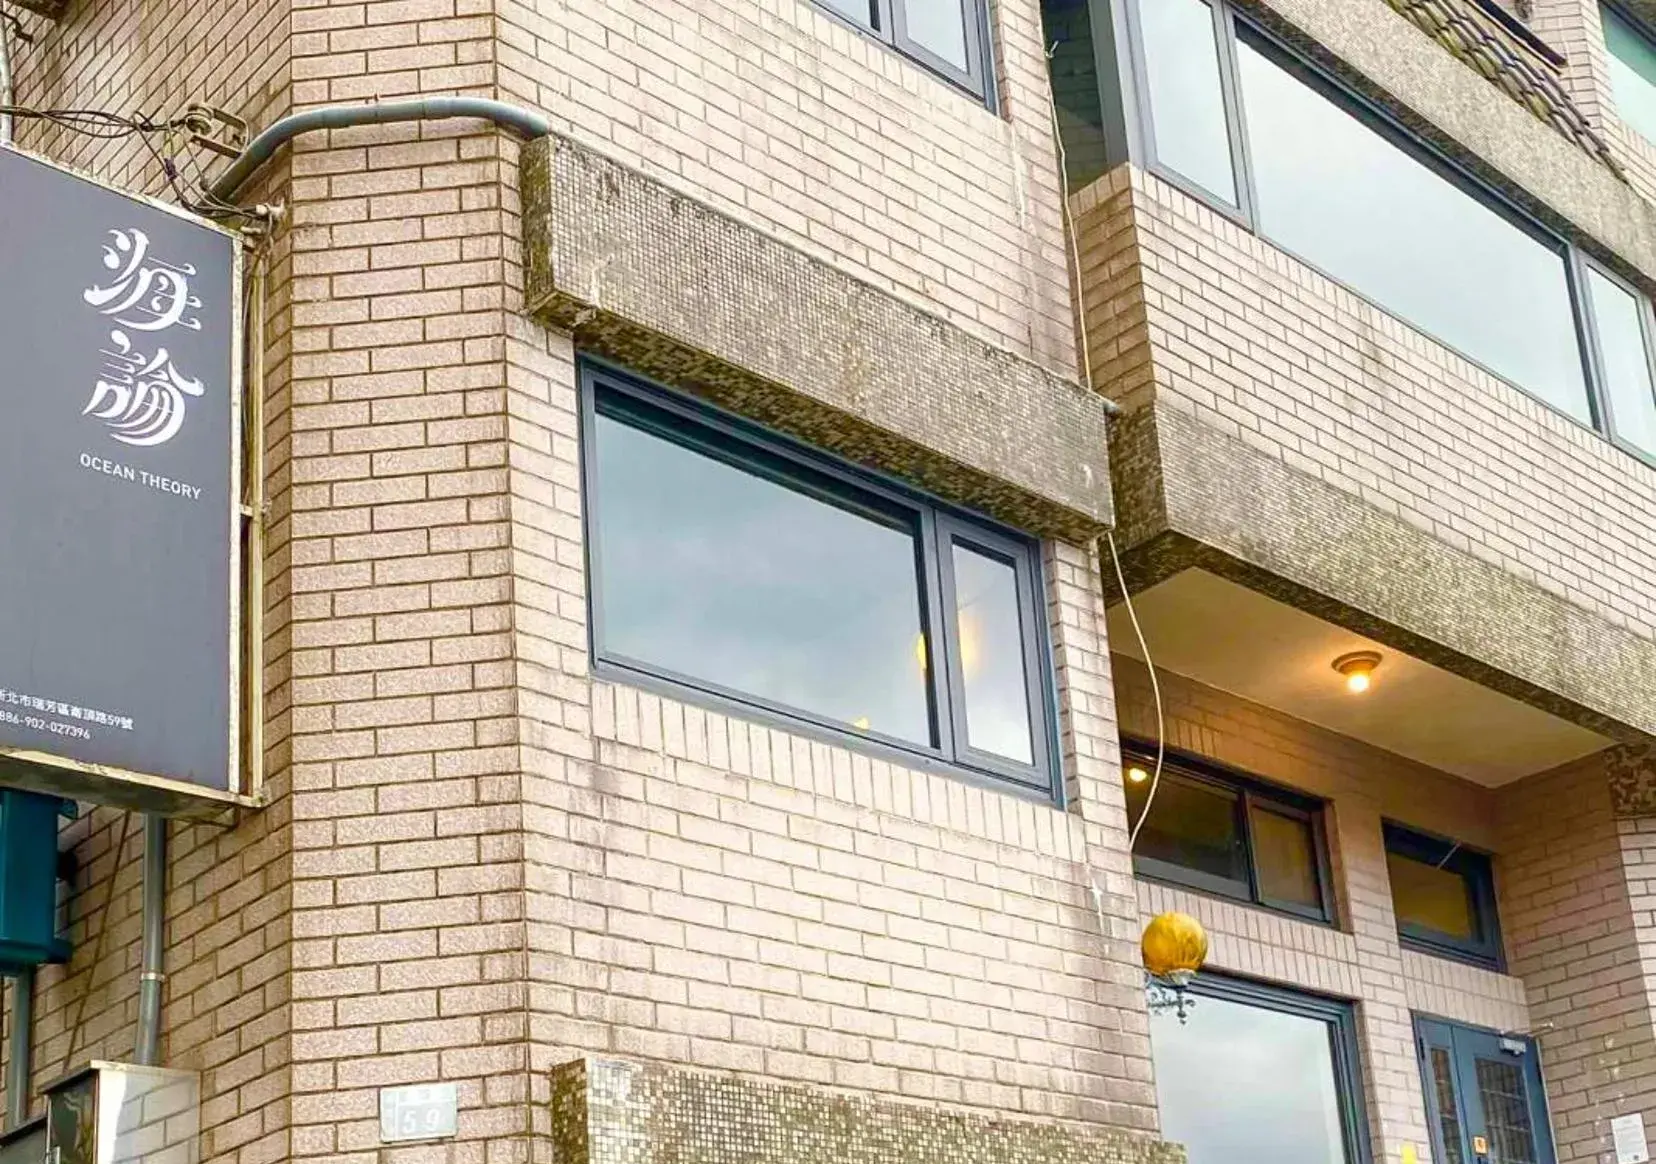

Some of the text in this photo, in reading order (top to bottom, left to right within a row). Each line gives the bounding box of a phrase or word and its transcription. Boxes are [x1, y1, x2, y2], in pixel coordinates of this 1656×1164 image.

[80, 453, 201, 500] OCEAN THEORY
[402, 1108, 440, 1134] 59
